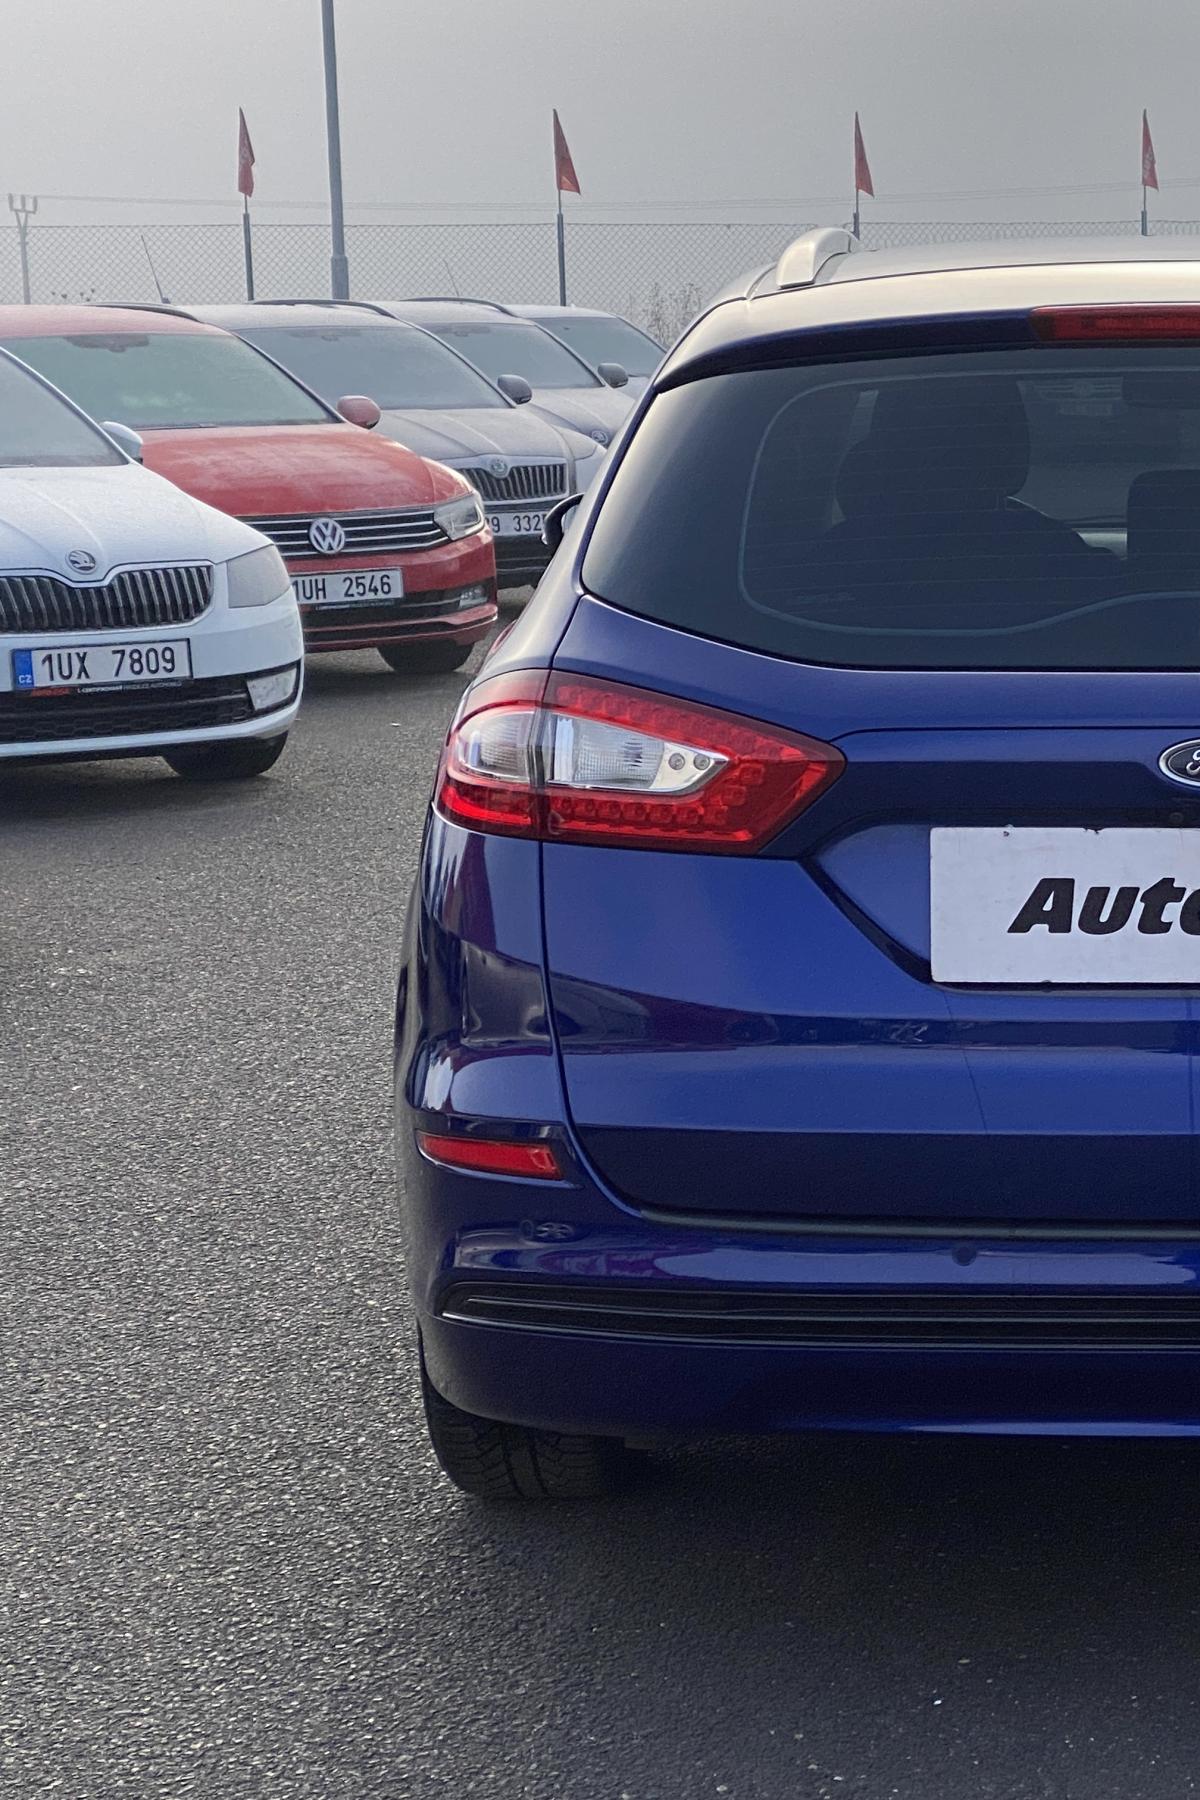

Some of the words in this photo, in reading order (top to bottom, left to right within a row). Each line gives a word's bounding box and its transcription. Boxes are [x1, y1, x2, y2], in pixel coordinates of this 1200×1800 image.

[512, 514, 546, 532] 332
[292, 578, 327, 602] 1UH
[343, 574, 392, 597] 2546
[41, 651, 90, 682] 1UX
[111, 646, 176, 678] 7809
[18, 674, 32, 684] CZ
